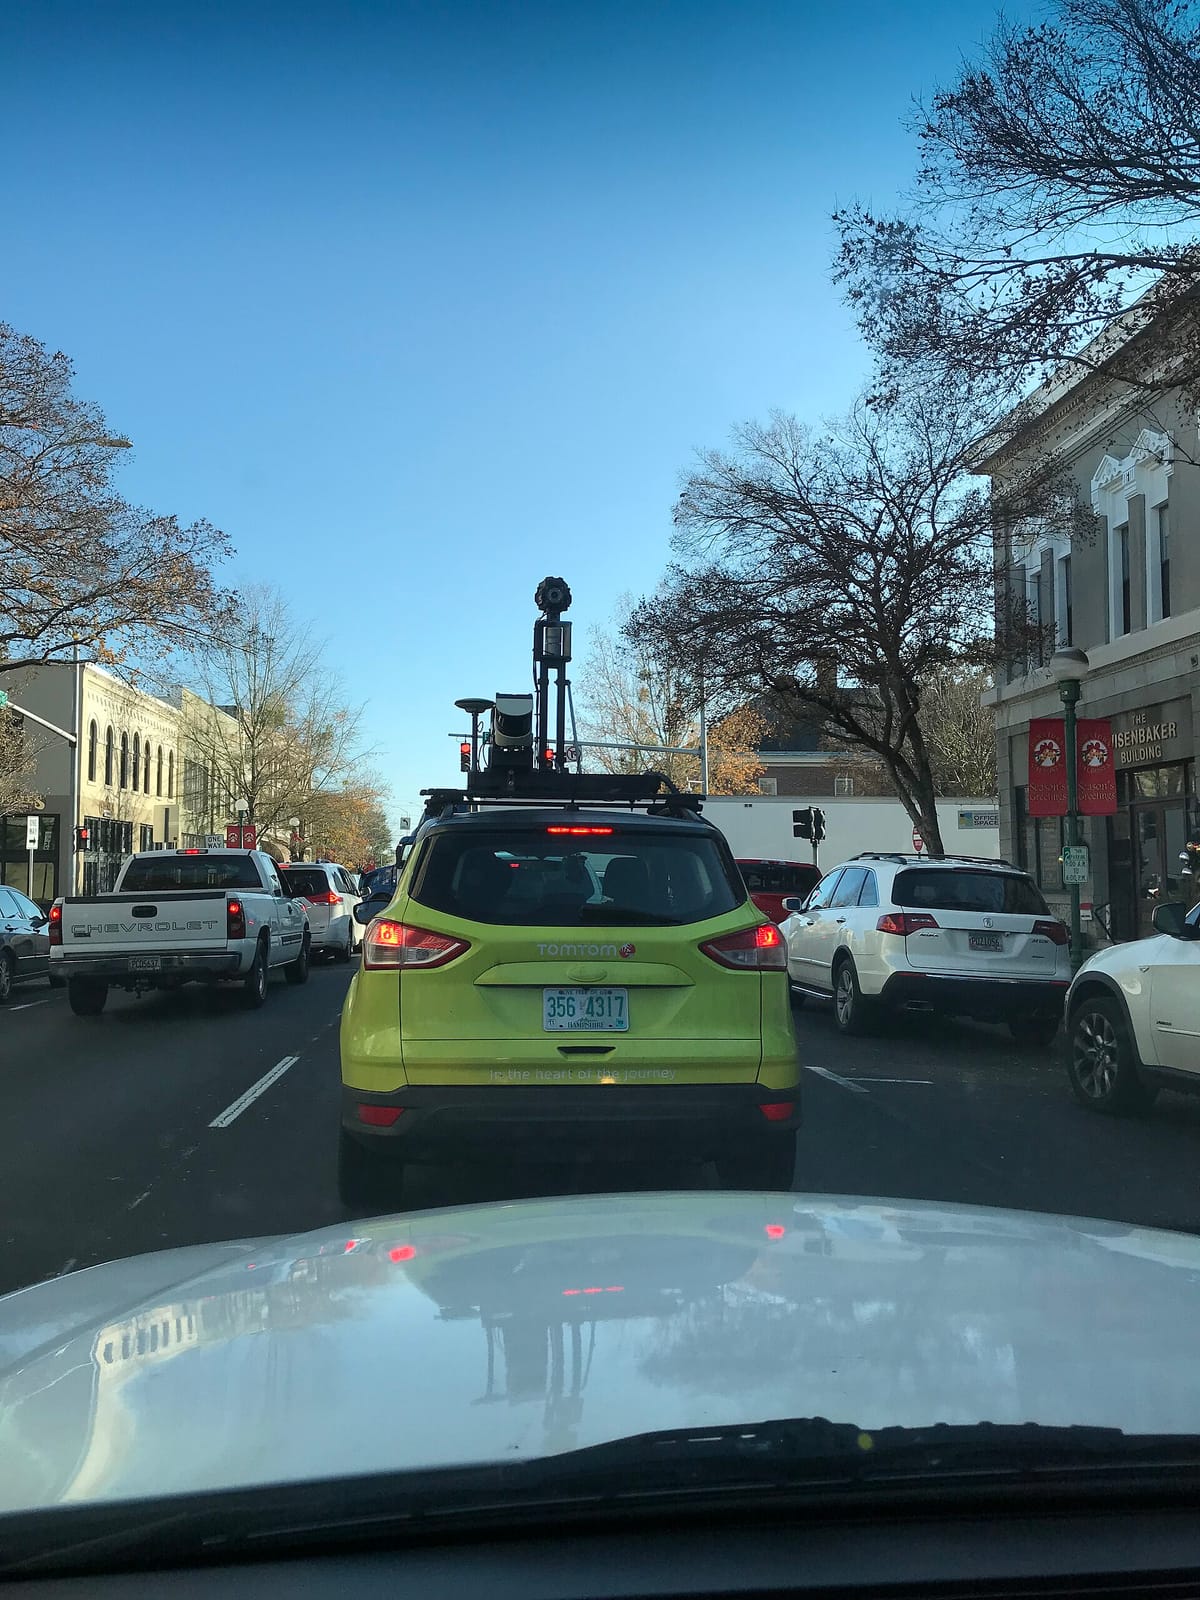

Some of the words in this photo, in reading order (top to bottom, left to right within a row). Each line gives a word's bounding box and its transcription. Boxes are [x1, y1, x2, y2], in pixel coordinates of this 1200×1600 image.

[1132, 713, 1146, 724] THE
[1120, 745, 1162, 764] BUILDING
[71, 920, 218, 934] CHEVROLET
[547, 996, 576, 1017] 356
[585, 996, 624, 1017] 4317
[508, 1068, 530, 1080] the
[536, 1068, 573, 1080] heart
[577, 1069, 592, 1079] of
[596, 1067, 620, 1079] the
[624, 1067, 676, 1081] journey
